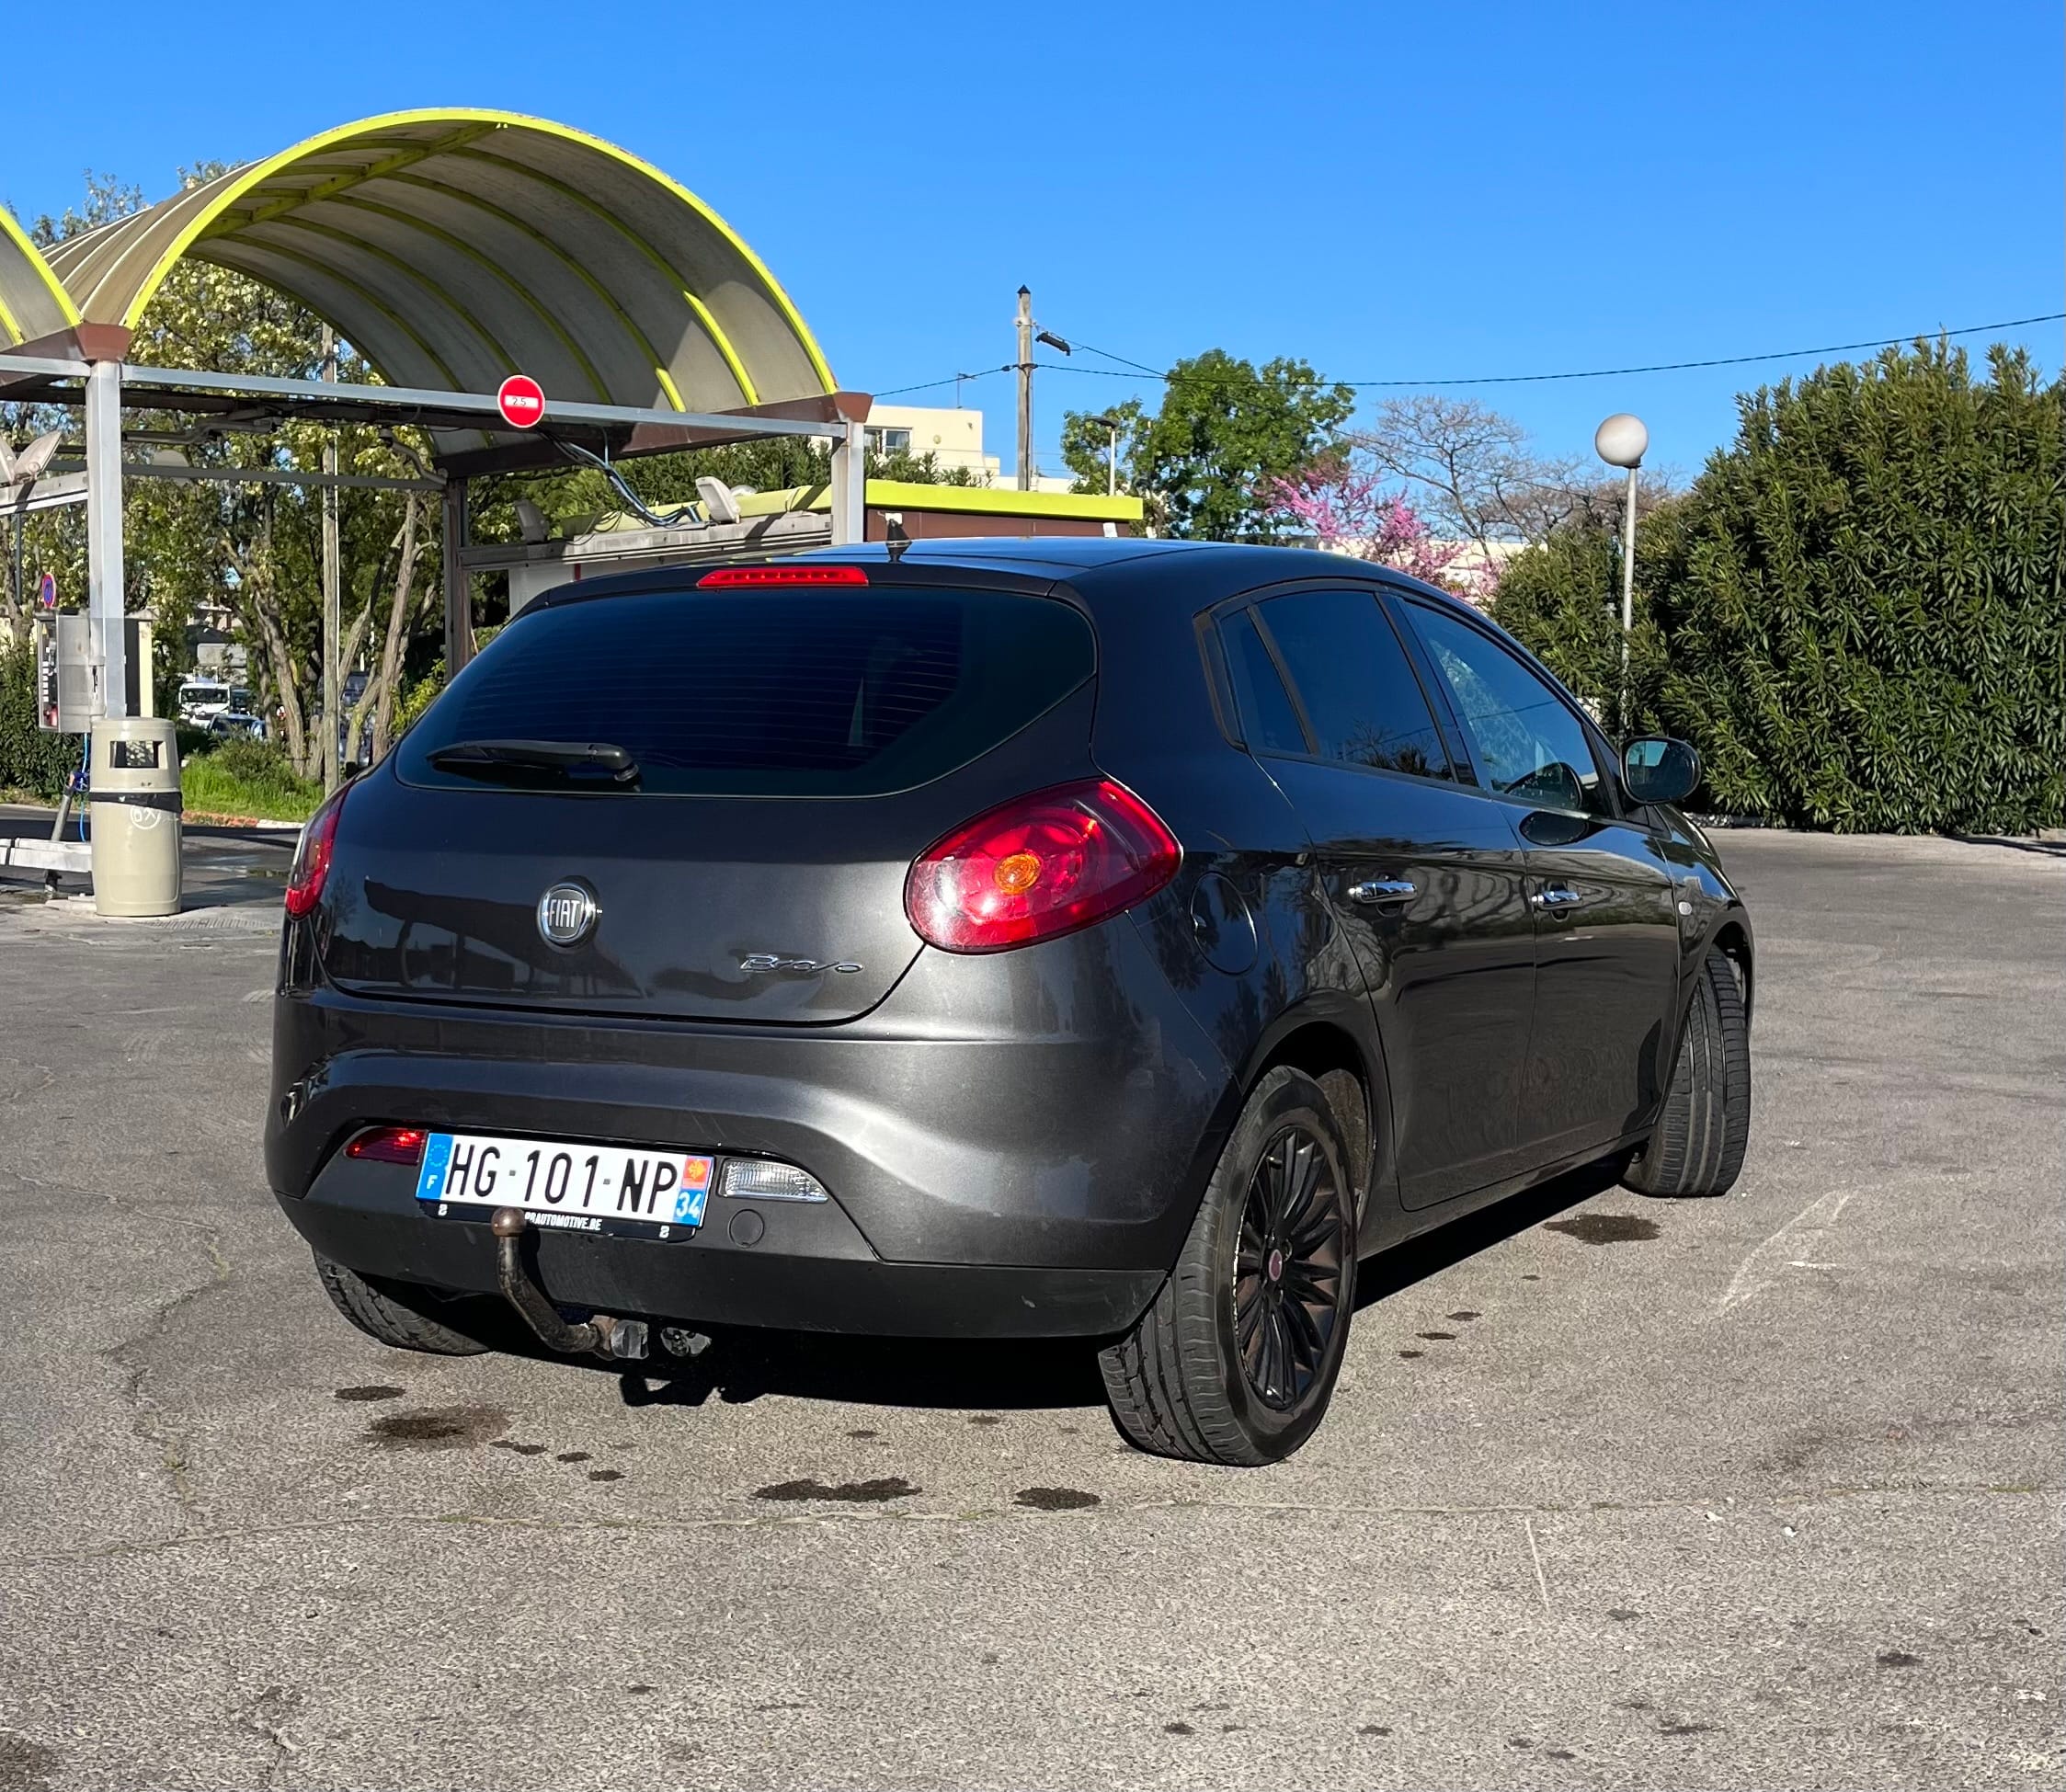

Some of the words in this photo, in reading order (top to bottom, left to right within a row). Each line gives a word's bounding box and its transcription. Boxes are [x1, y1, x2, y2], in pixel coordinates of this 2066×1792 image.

[549, 898, 581, 928] FIAT
[426, 1174, 439, 1190] F
[675, 1191, 702, 1219] 34
